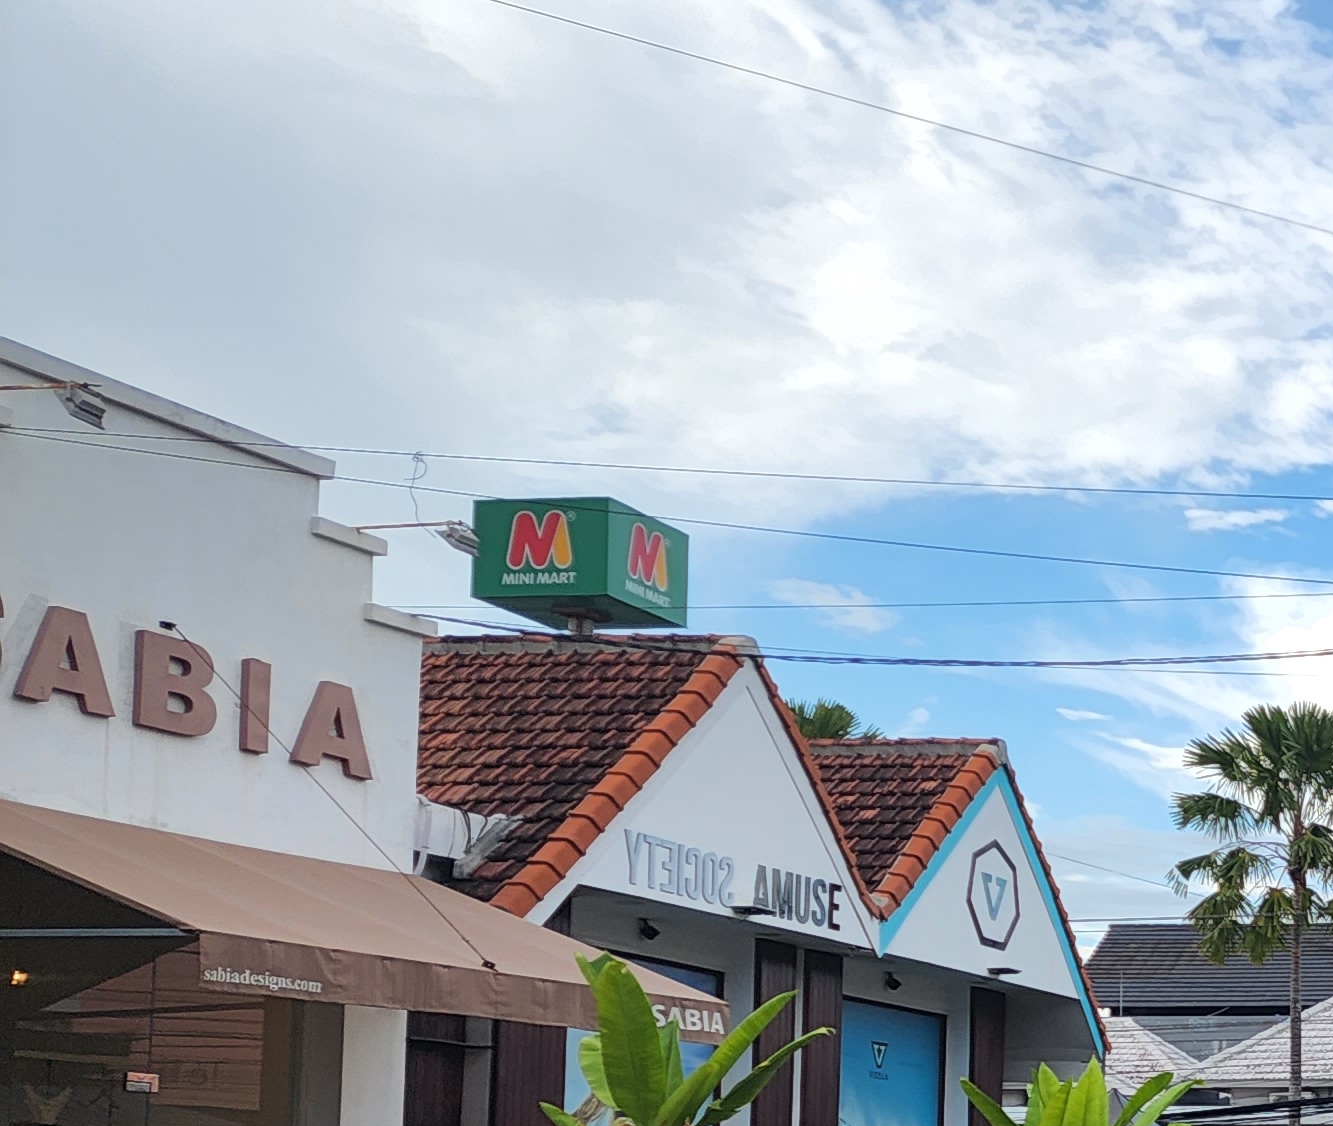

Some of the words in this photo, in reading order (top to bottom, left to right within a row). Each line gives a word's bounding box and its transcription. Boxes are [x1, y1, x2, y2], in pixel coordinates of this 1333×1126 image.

[502, 572, 534, 585] MINI
[536, 571, 577, 584] MART
[624, 578, 647, 598] MINI
[644, 586, 672, 608] MART
[0, 592, 374, 780] ABIA
[752, 864, 843, 932] AMUSE
[203, 966, 323, 993] sabiadesigns.com
[652, 1004, 726, 1035] SABIA
